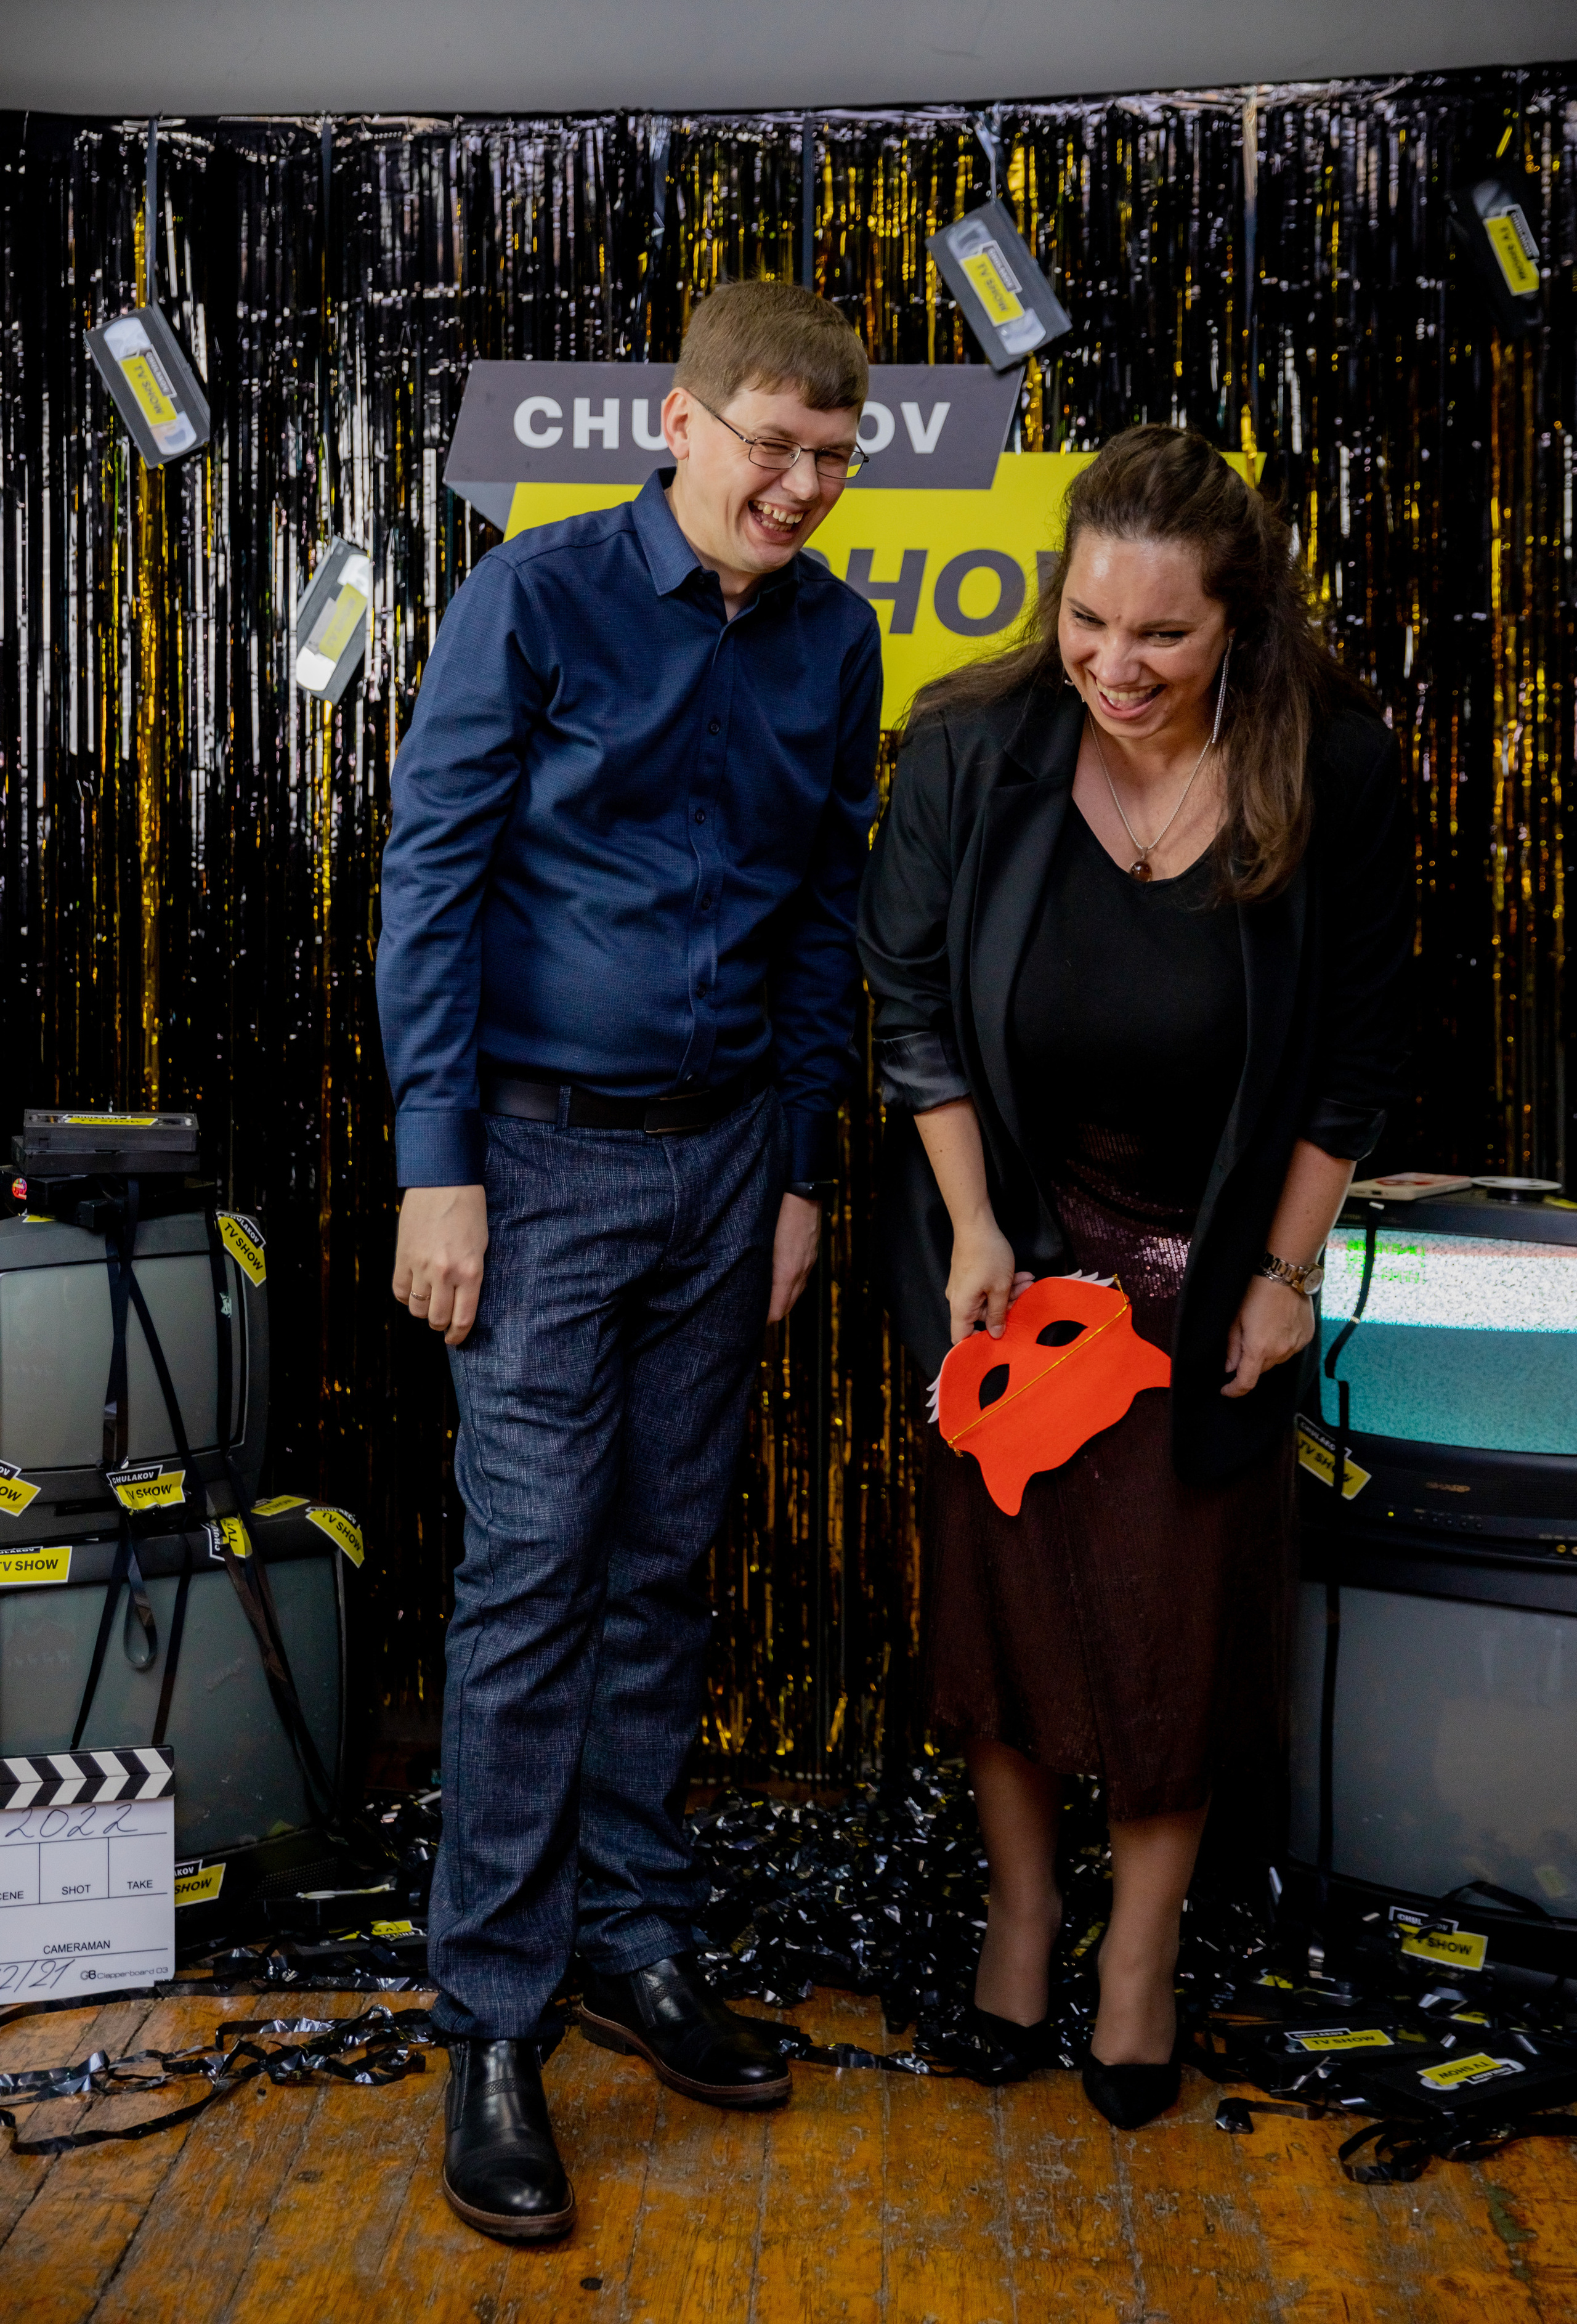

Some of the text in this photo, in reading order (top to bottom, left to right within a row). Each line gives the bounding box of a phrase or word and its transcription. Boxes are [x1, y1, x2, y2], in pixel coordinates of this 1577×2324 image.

[513, 396, 951, 454] CHUOV
[224, 1222, 264, 1270] TV SHOW
[111, 1471, 155, 1484] CHULAKOV
[136, 1484, 172, 1498] SHOW
[228, 1527, 238, 1543] TV
[322, 1512, 362, 1551] TV SHOW
[15, 1559, 59, 1571] SHOW
[6, 1803, 138, 1838] 2022
[61, 1884, 92, 1896] SHOT
[126, 1879, 153, 1890] TAKE
[175, 1877, 213, 1895] SHOW
[0, 1890, 24, 1901] ENE
[43, 1940, 111, 1955] CAMERAMAN
[1428, 1937, 1473, 1956] SHOW
[0, 1959, 75, 1993] 2/21
[97, 1967, 154, 1981] Clapperboard
[156, 1966, 168, 1975] 03
[1332, 2036, 1375, 2044] SHOW
[1438, 2065, 1475, 2079] SHOW
